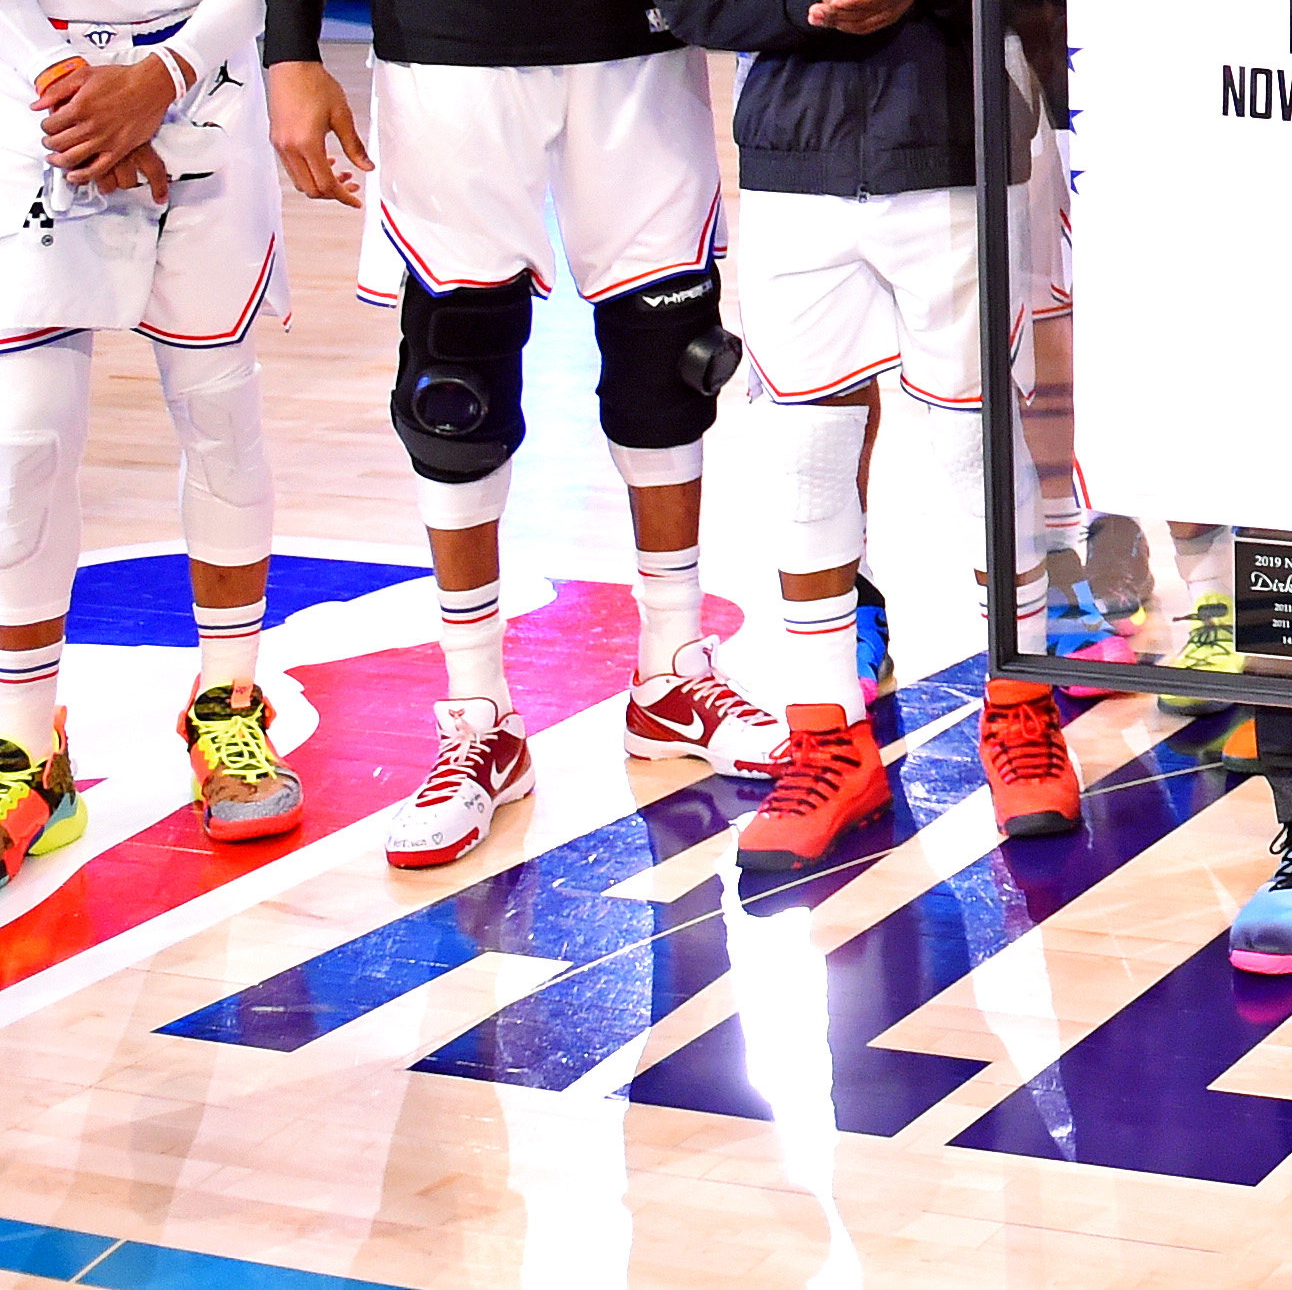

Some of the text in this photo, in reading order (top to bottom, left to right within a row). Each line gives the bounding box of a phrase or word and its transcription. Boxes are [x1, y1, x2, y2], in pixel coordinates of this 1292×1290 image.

[1254, 555, 1282, 568] 2019
[1273, 602, 1292, 613] 2011
[1272, 618, 1291, 628] 2011
